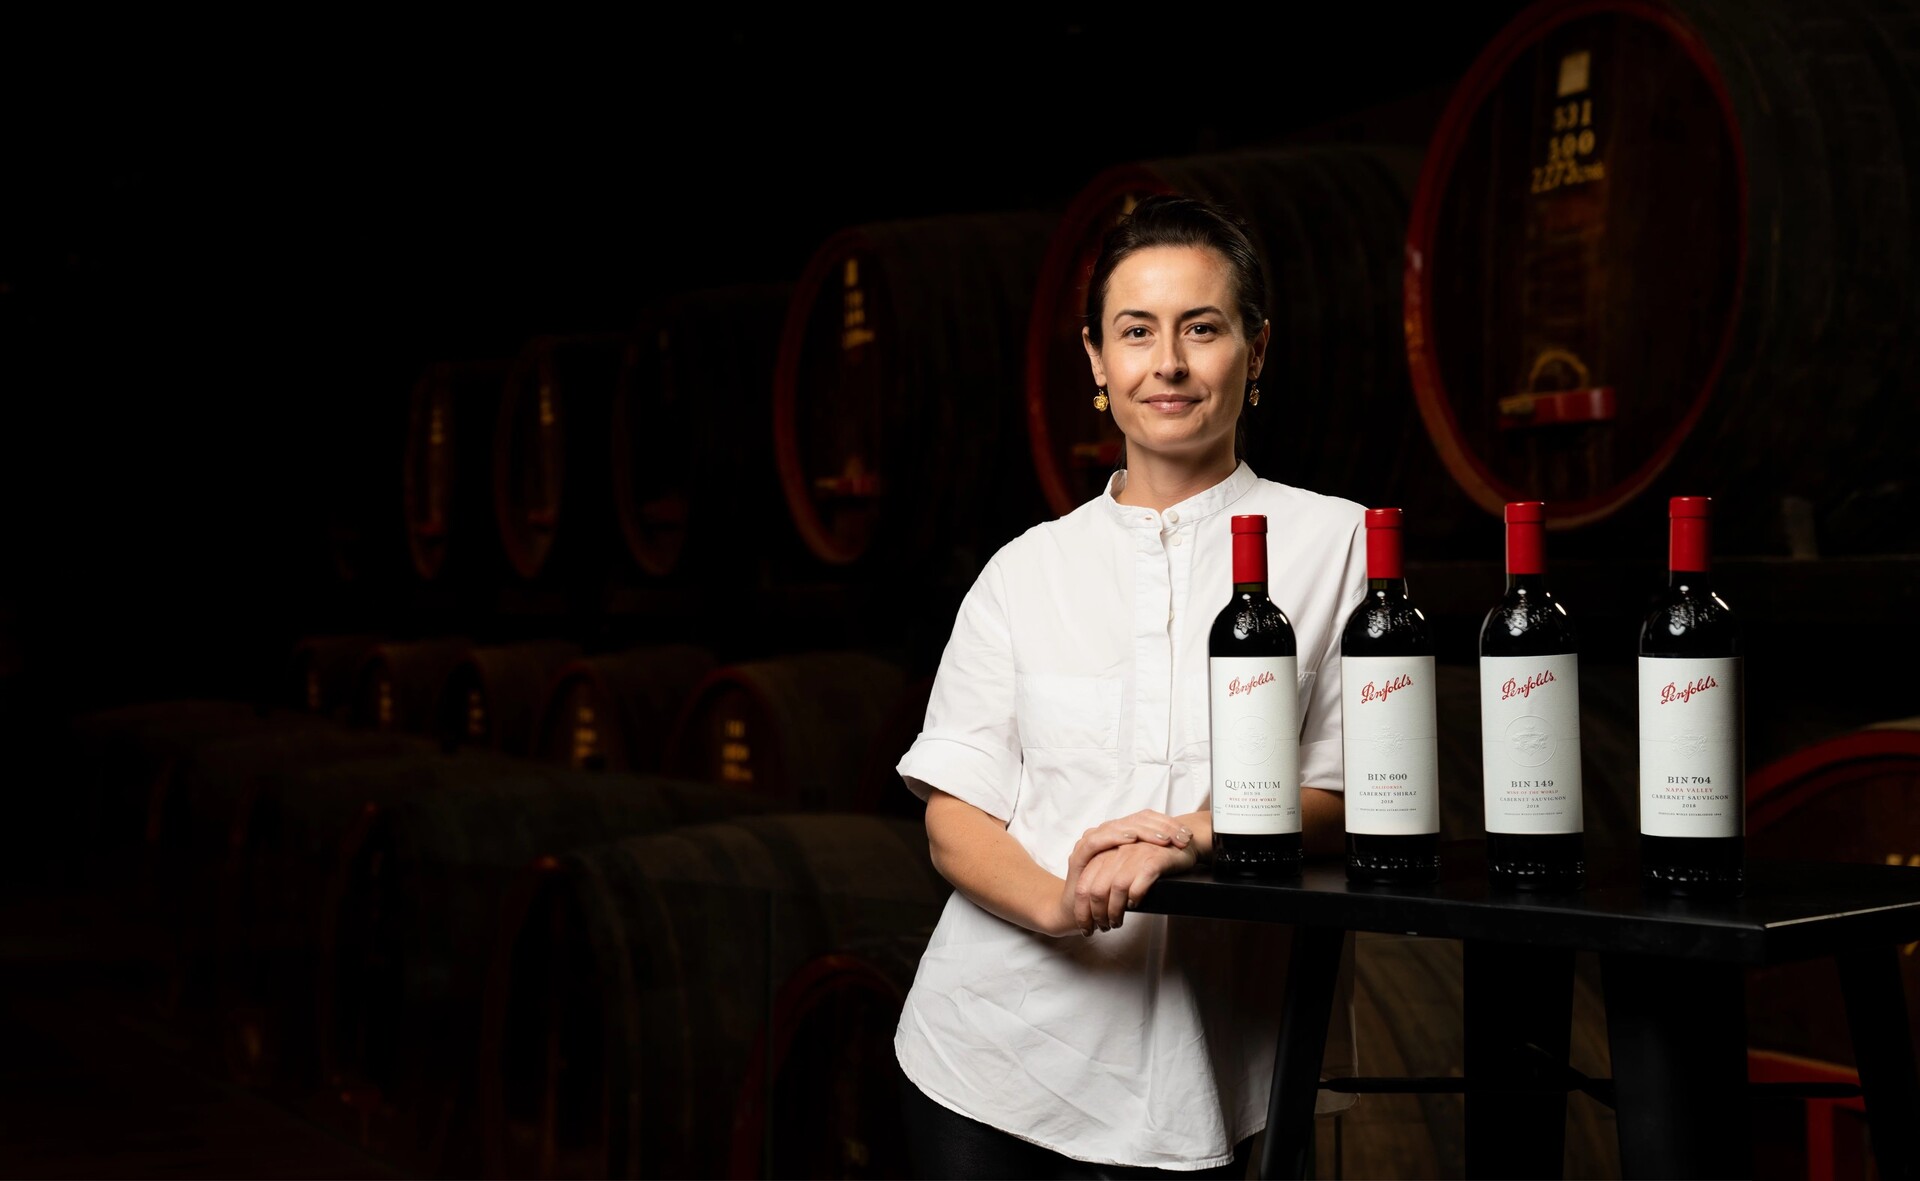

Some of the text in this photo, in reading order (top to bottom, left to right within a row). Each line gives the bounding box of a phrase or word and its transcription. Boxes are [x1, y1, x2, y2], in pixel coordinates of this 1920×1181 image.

[1229, 671, 1275, 697] Penfolds
[1361, 674, 1412, 704] Penfolds
[1501, 670, 1554, 700] Penfolds
[1661, 676, 1717, 705] Penfolds
[1225, 780, 1281, 791] QUANTUM
[1368, 773, 1408, 781] BIN 600
[1511, 780, 1554, 788] BIN 149
[1667, 776, 1712, 784] BIN 704
